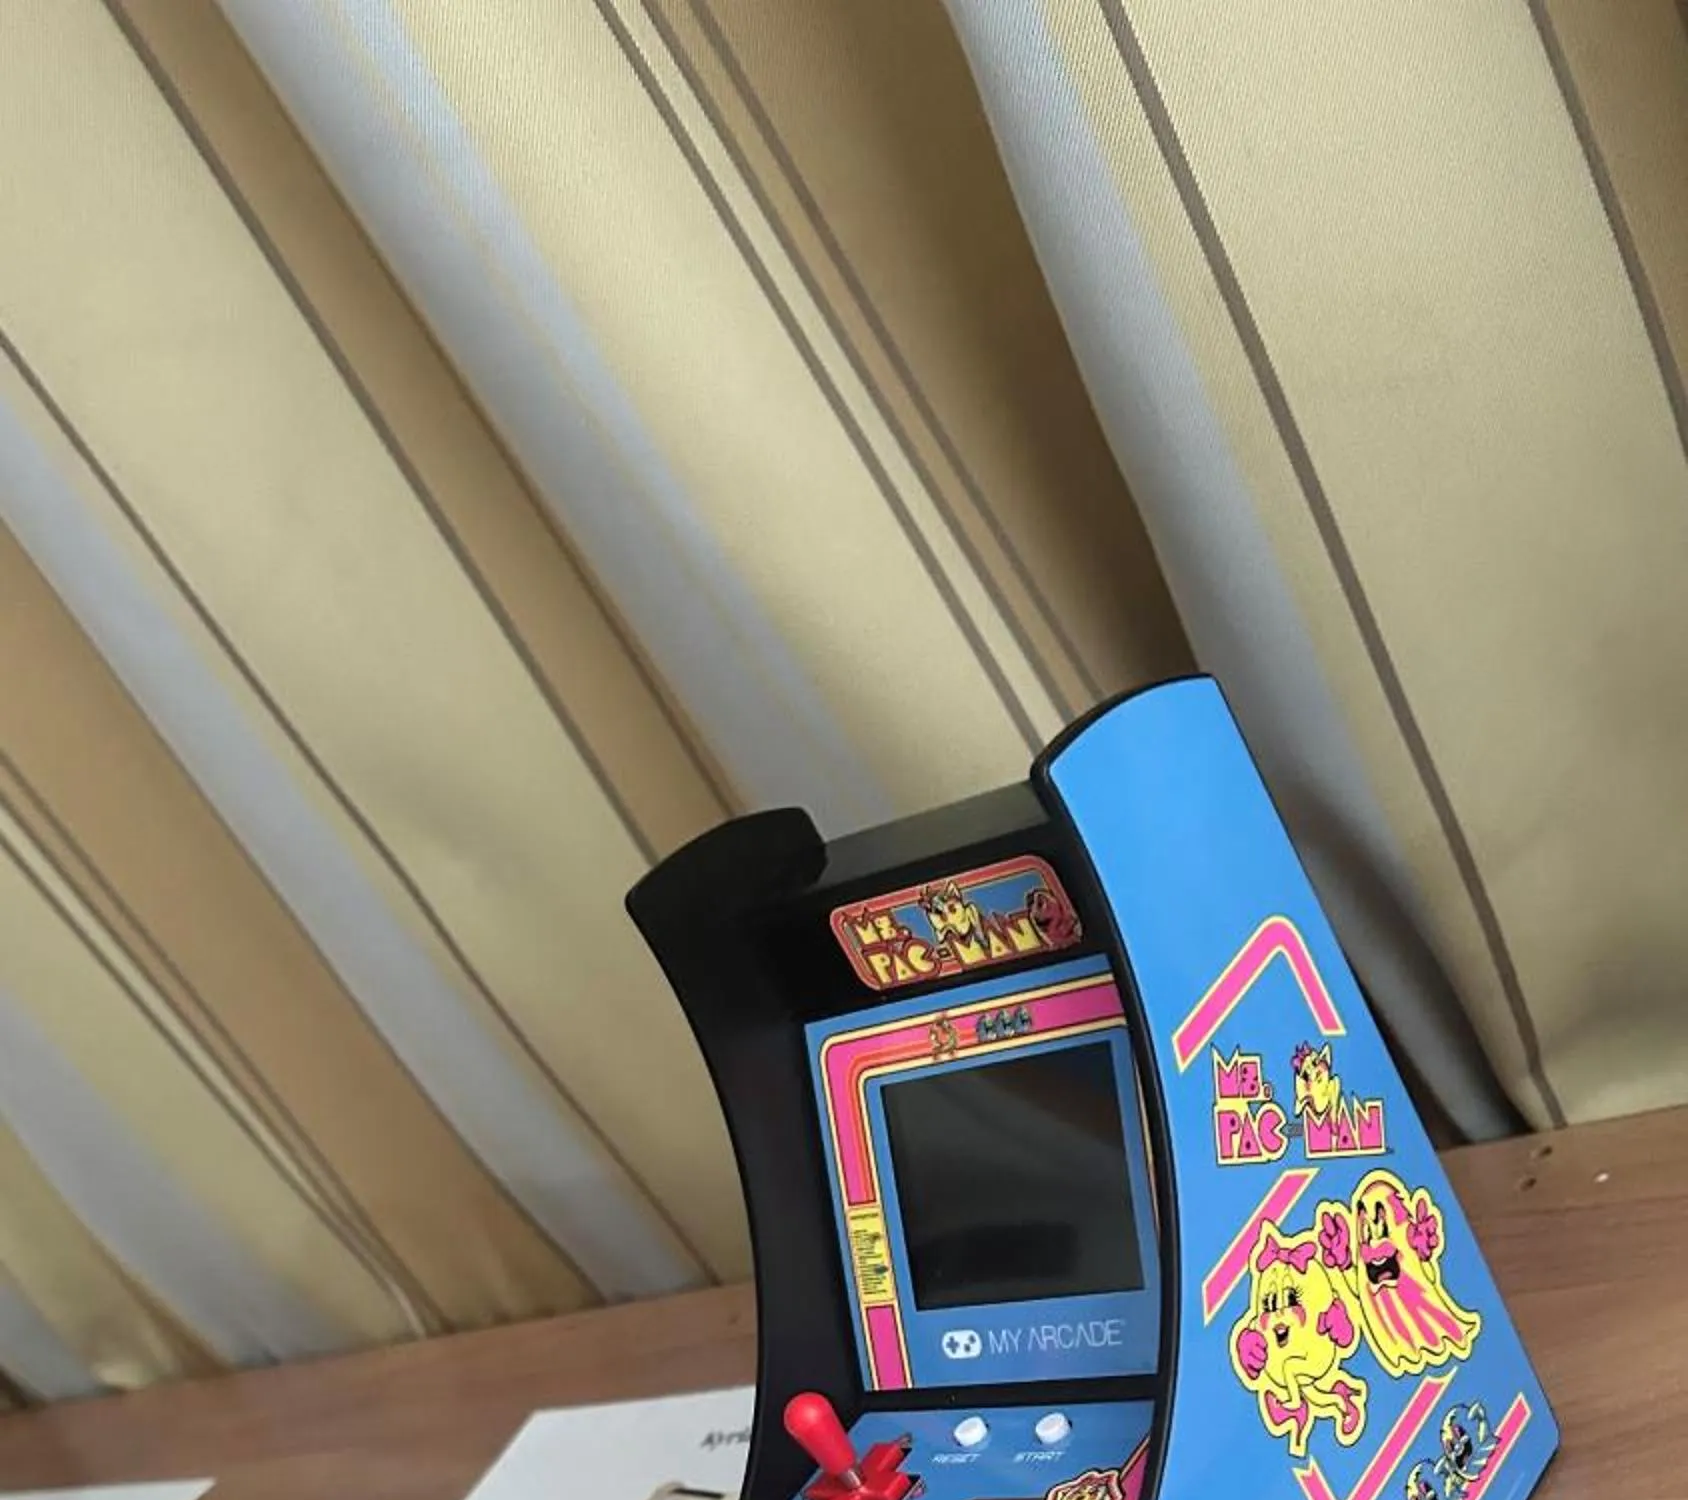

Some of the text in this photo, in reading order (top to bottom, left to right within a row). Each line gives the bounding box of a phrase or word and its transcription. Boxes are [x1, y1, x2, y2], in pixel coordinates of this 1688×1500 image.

[866, 912, 1042, 984] PAC-MAN
[988, 1328, 1021, 1353] MY
[931, 1451, 1065, 1464] RESET START
